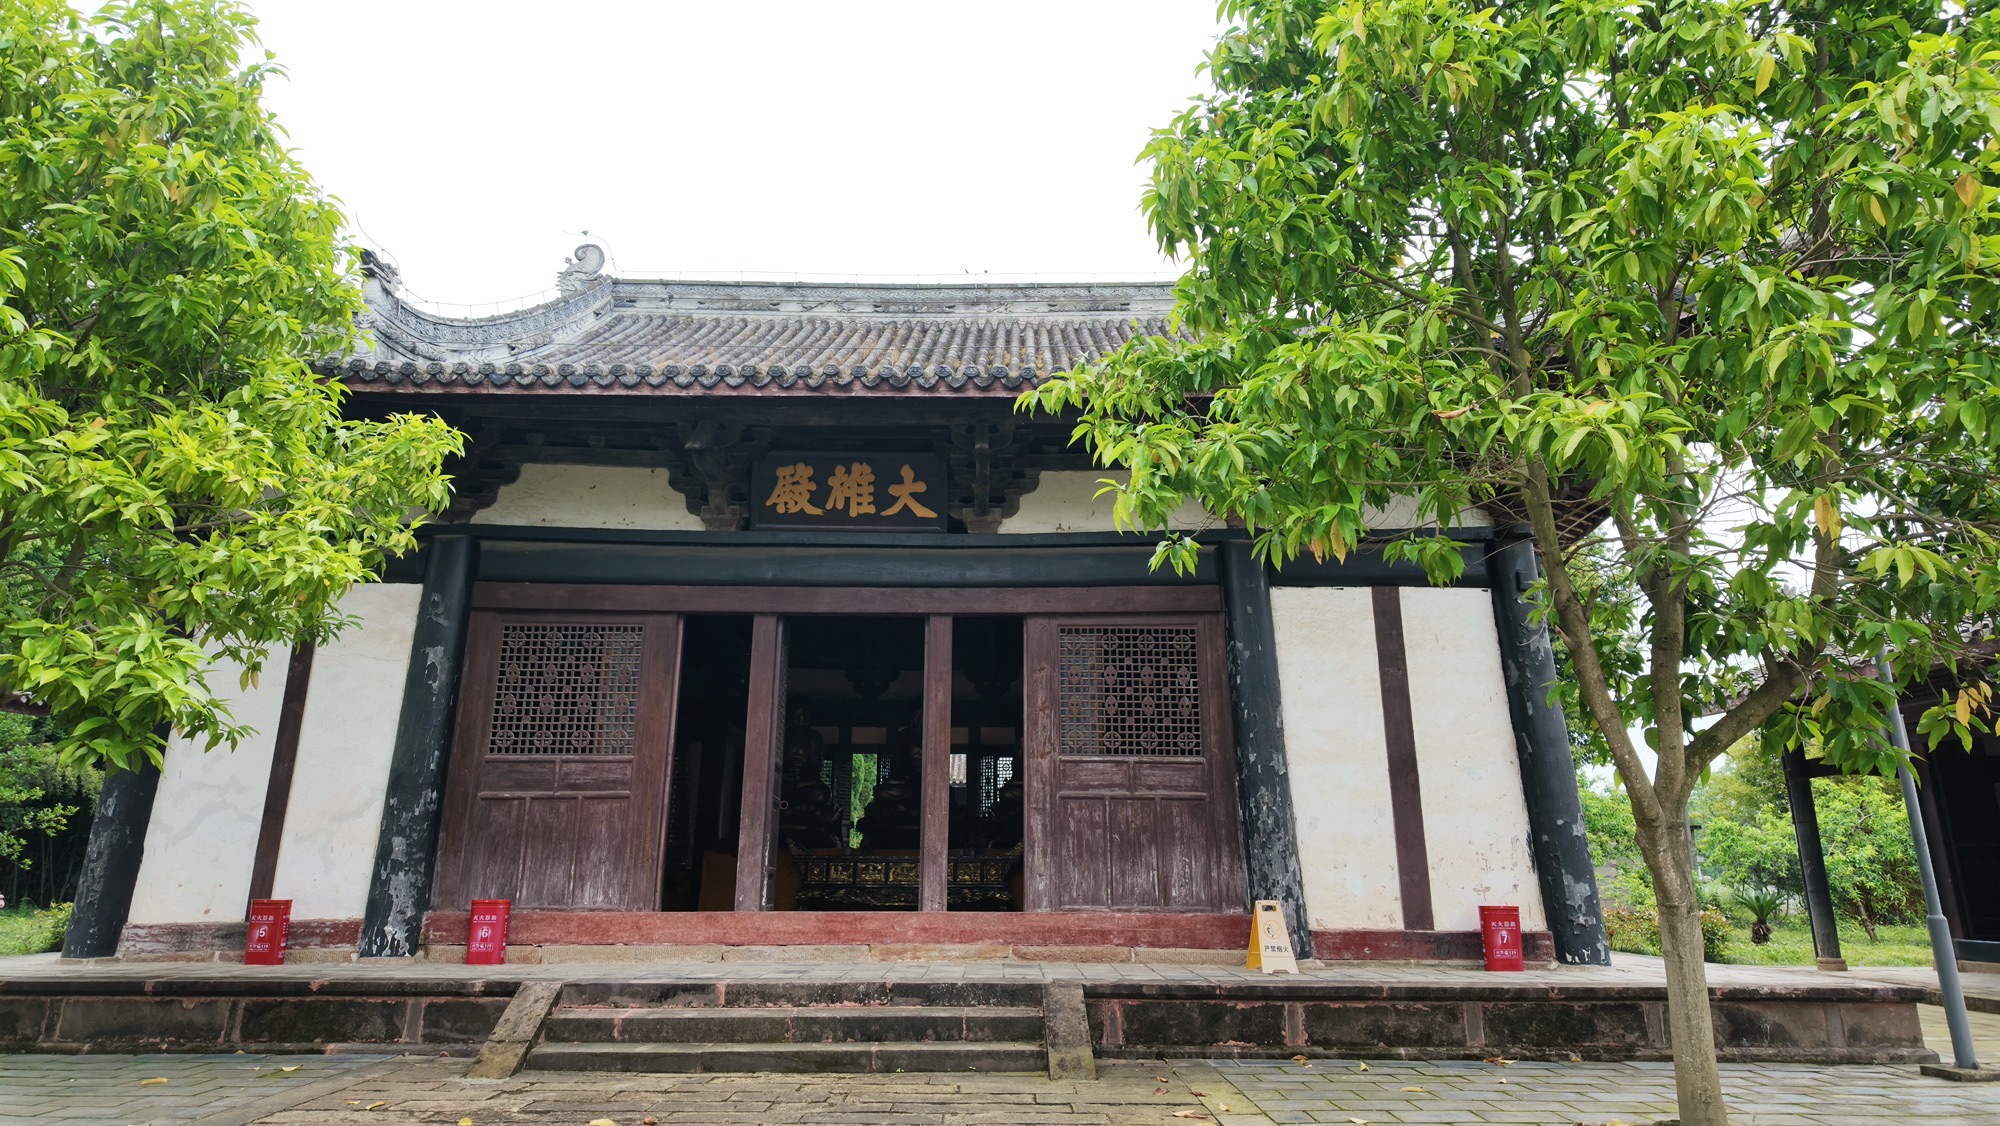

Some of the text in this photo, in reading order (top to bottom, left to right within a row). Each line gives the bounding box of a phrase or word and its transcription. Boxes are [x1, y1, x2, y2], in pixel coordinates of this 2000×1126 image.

[259, 927, 266, 937] 5
[481, 928, 488, 938] 6
[1501, 934, 1508, 944] 7
[1264, 945, 1289, 953] 严禁烟火
